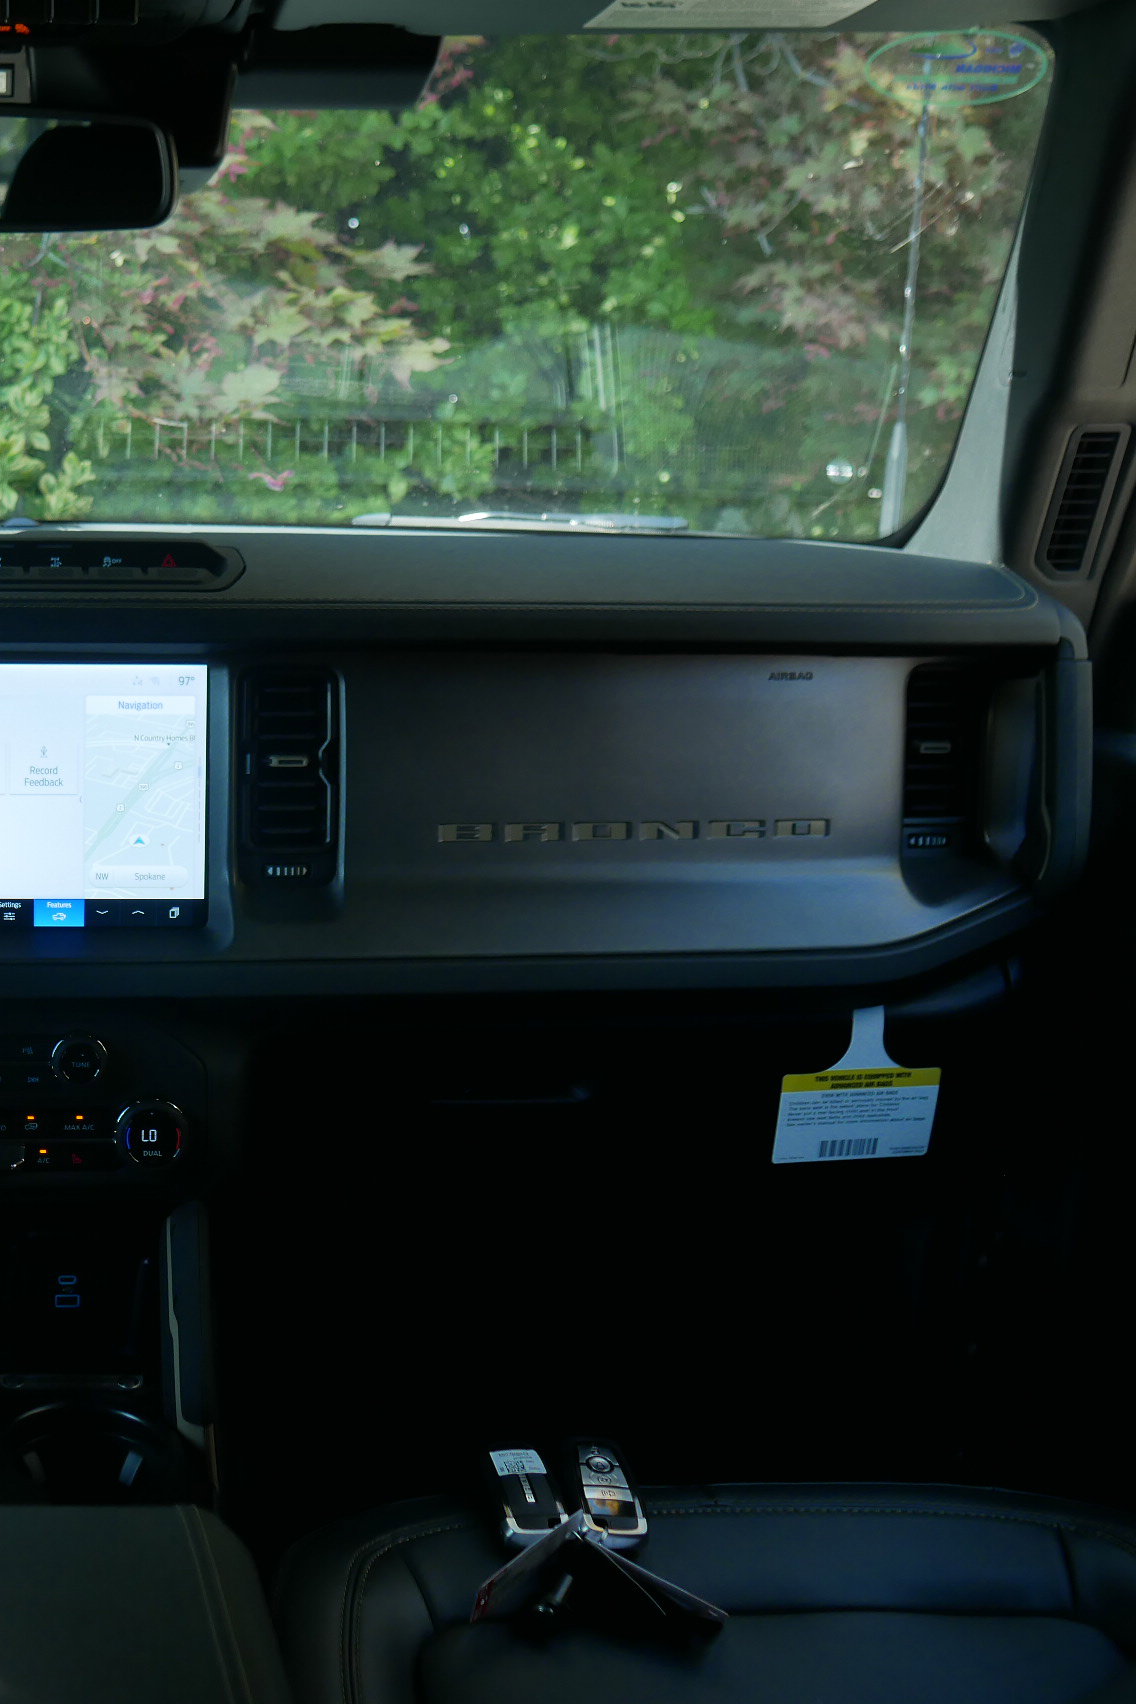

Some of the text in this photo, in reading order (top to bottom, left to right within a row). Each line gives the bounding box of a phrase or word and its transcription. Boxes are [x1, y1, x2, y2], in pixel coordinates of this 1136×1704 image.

[767, 671, 814, 681] AIRBAG
[118, 700, 163, 711] Navigation
[140, 734, 165, 743] Country
[29, 765, 59, 775] Record
[24, 777, 64, 787] Feedback
[437, 817, 831, 844] BRONCO
[95, 872, 109, 881] NW
[134, 872, 166, 882] Spokane
[46, 900, 72, 909] Features
[71, 1060, 91, 1068] TUNE
[141, 1128, 157, 1142] LO
[143, 1150, 163, 1158] DUAL
[37, 1156, 50, 1164] A/C
